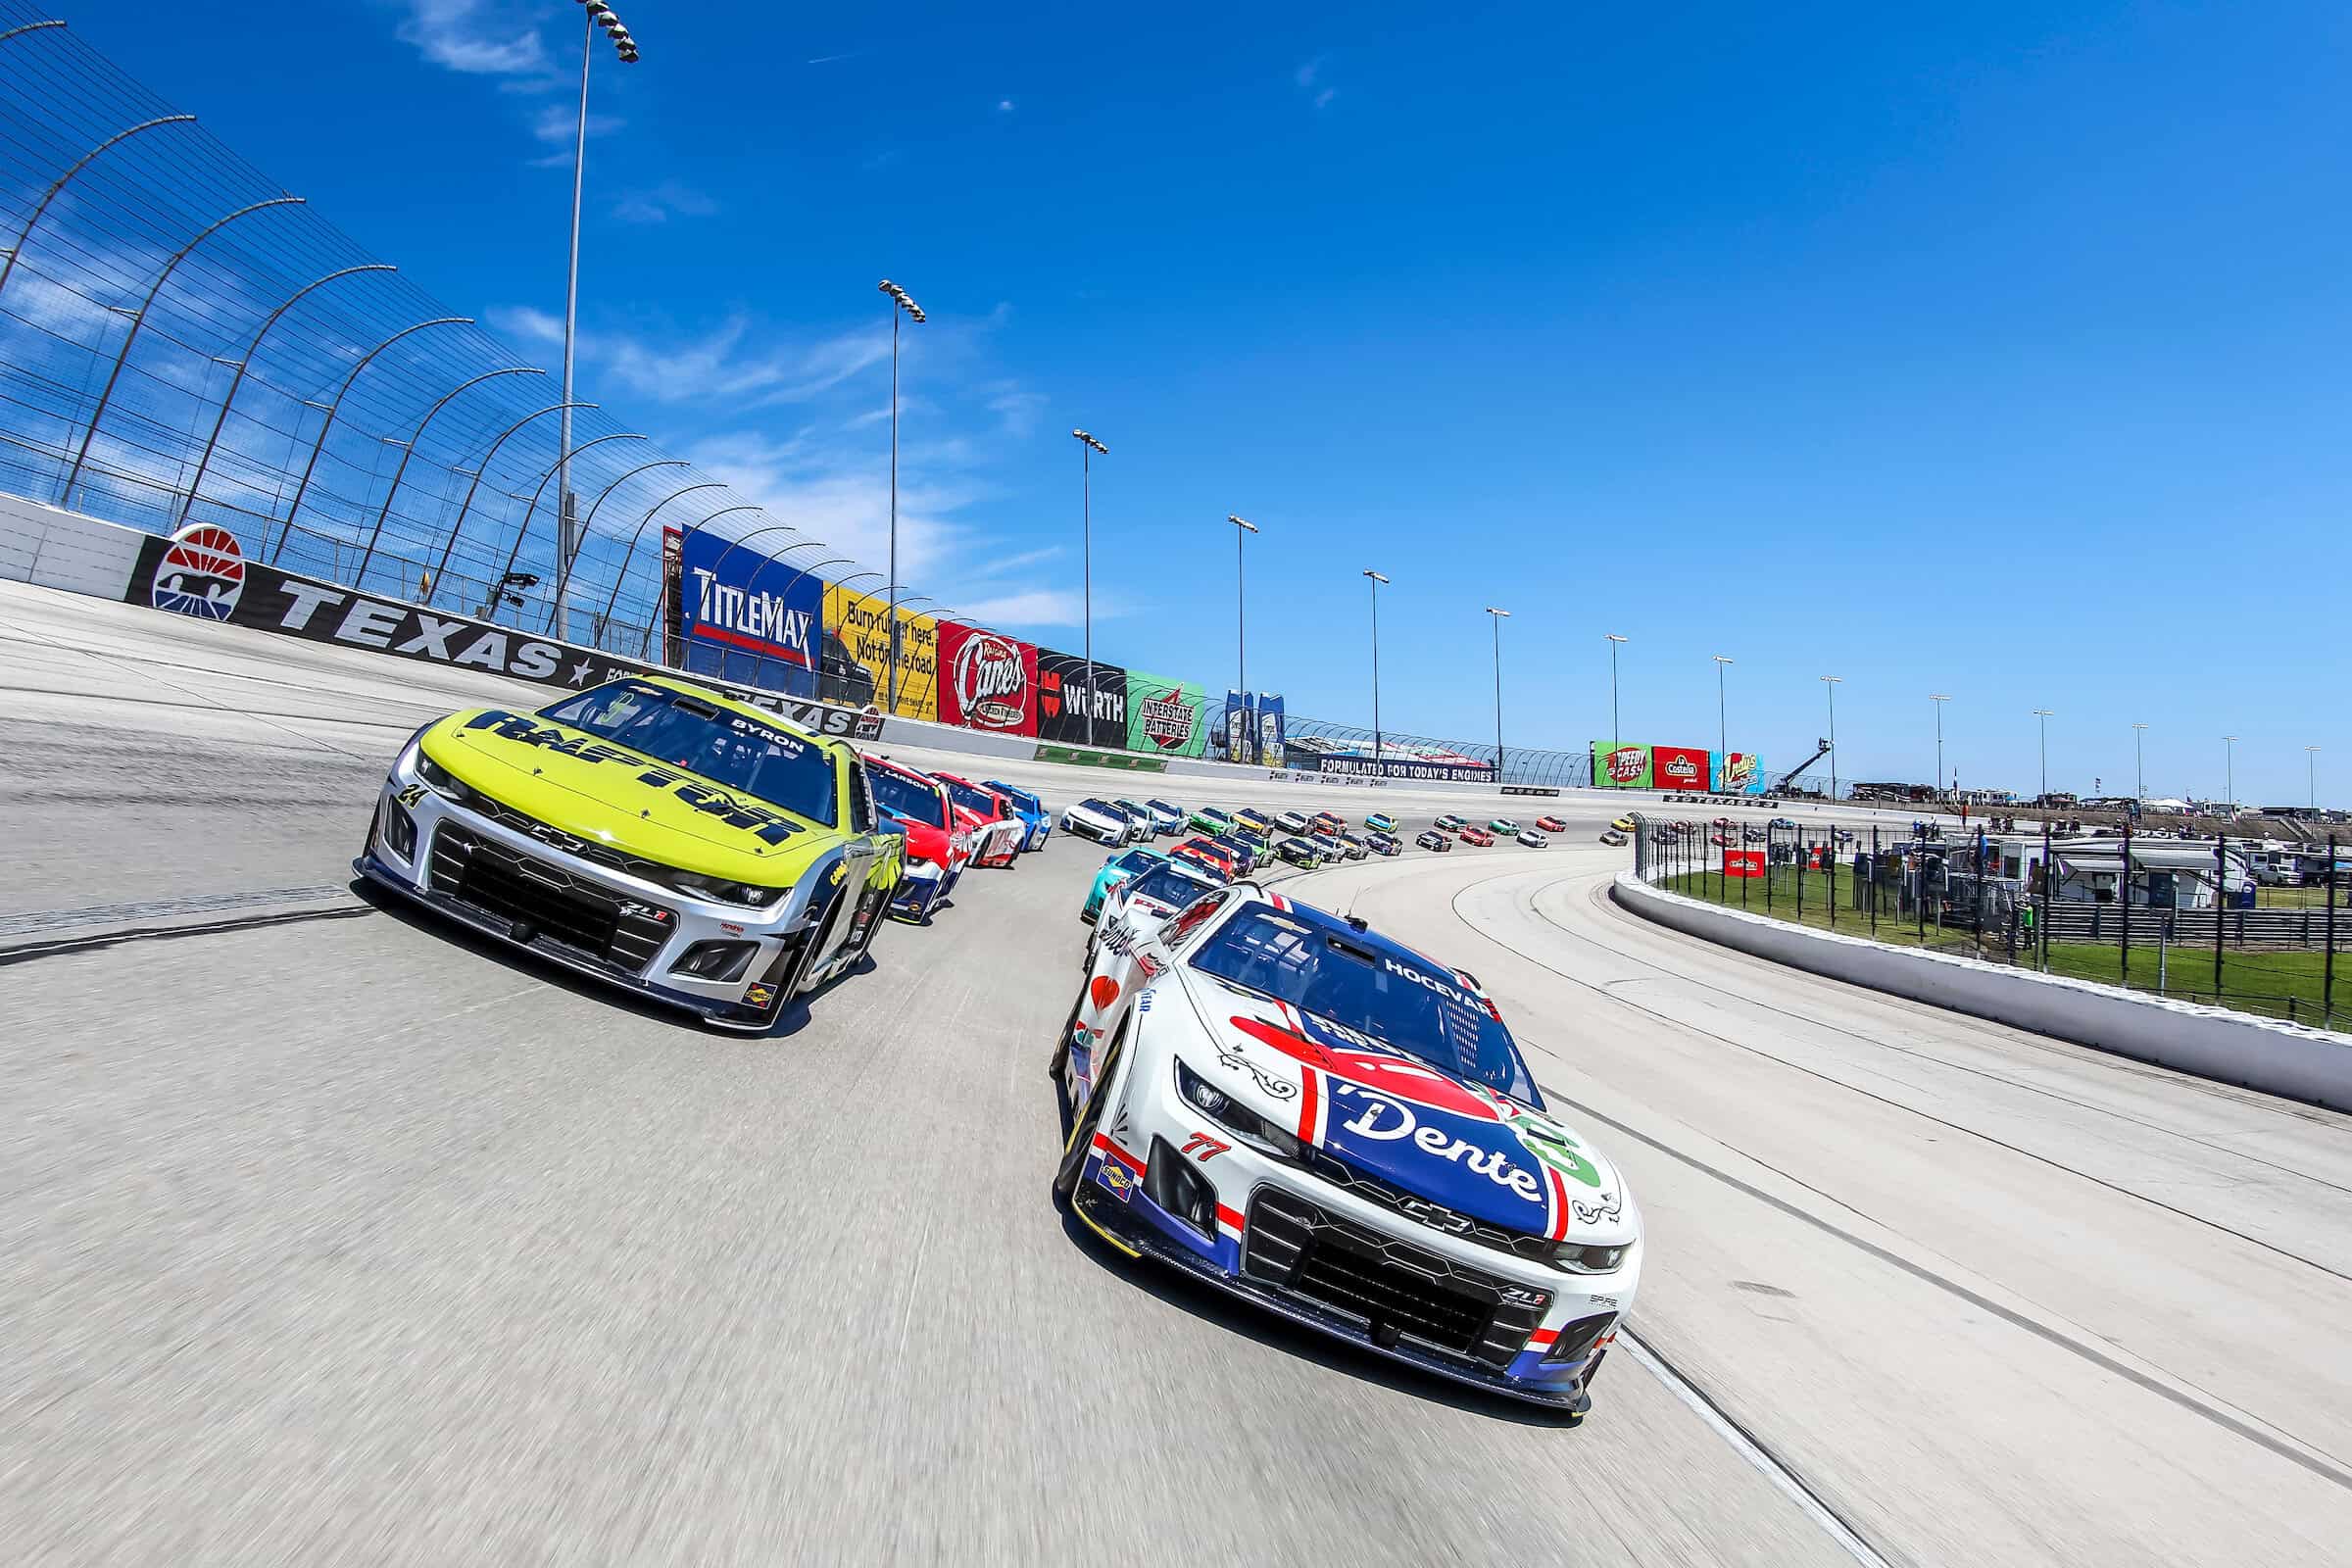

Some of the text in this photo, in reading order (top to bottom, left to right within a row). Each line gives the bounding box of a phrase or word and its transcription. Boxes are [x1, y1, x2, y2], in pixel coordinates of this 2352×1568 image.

[847, 601, 873, 629] Burn
[279, 580, 562, 678] TEXAS
[857, 636, 876, 662] Not
[983, 642, 1007, 659] Raising
[1143, 699, 1195, 721] INTERSTATE
[731, 718, 805, 754] BYRON
[1145, 718, 1191, 739] BATTERIES
[885, 769, 929, 791] LARSON
[1320, 759, 1384, 776] FORMULATED
[1387, 763, 1407, 777] FOR
[1408, 765, 1448, 781] TODAY'S
[1451, 768, 1492, 783] ENGINES
[397, 783, 430, 809] 24
[1385, 958, 1495, 1020] HOCEVAR
[1181, 1131, 1231, 1161] 77
[1102, 1165, 1132, 1189] SUNOCO
